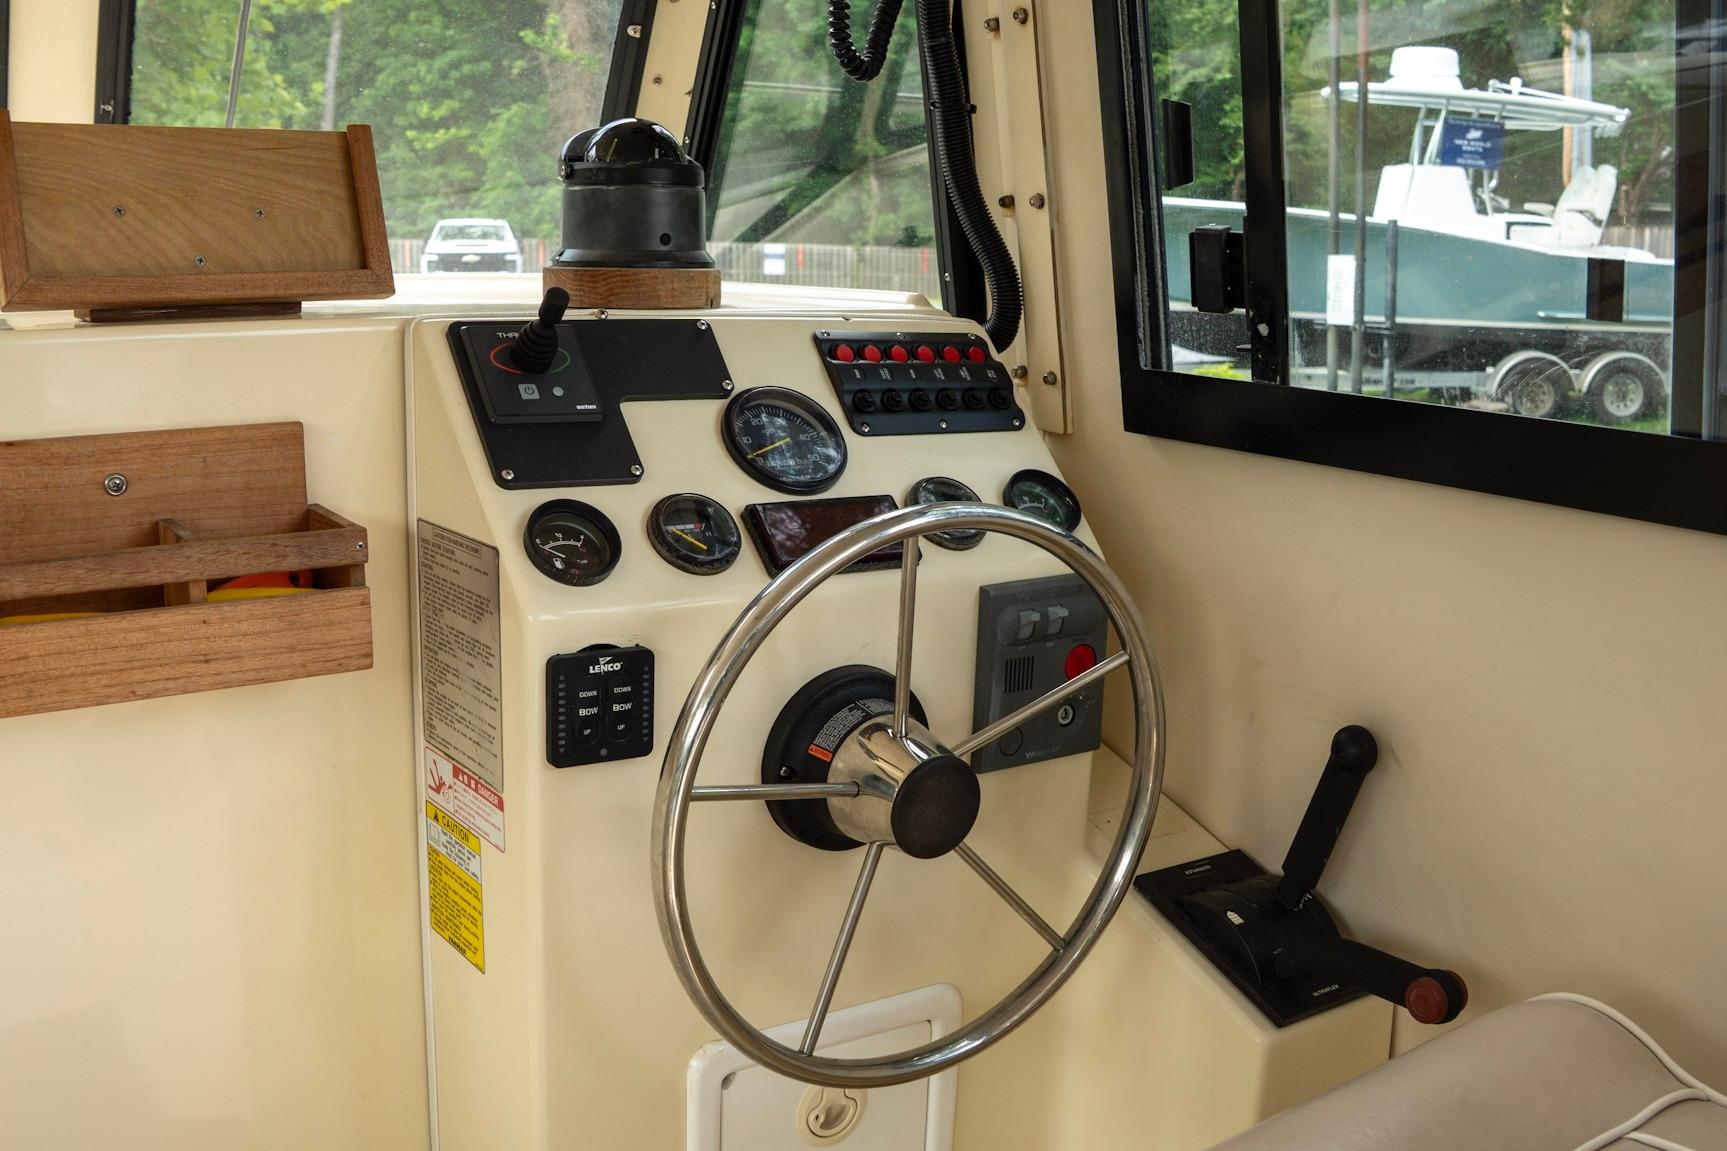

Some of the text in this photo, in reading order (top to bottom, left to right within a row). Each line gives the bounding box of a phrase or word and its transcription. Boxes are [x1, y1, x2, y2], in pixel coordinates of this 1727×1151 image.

[751, 418, 762, 426] 20
[589, 661, 621, 675] LENCO
[613, 685, 632, 693] DOWN
[579, 690, 598, 698] DOWN
[579, 706, 599, 716] BOW
[612, 702, 632, 712] BOW
[583, 728, 592, 736] UP
[442, 815, 469, 843] CAUTION
